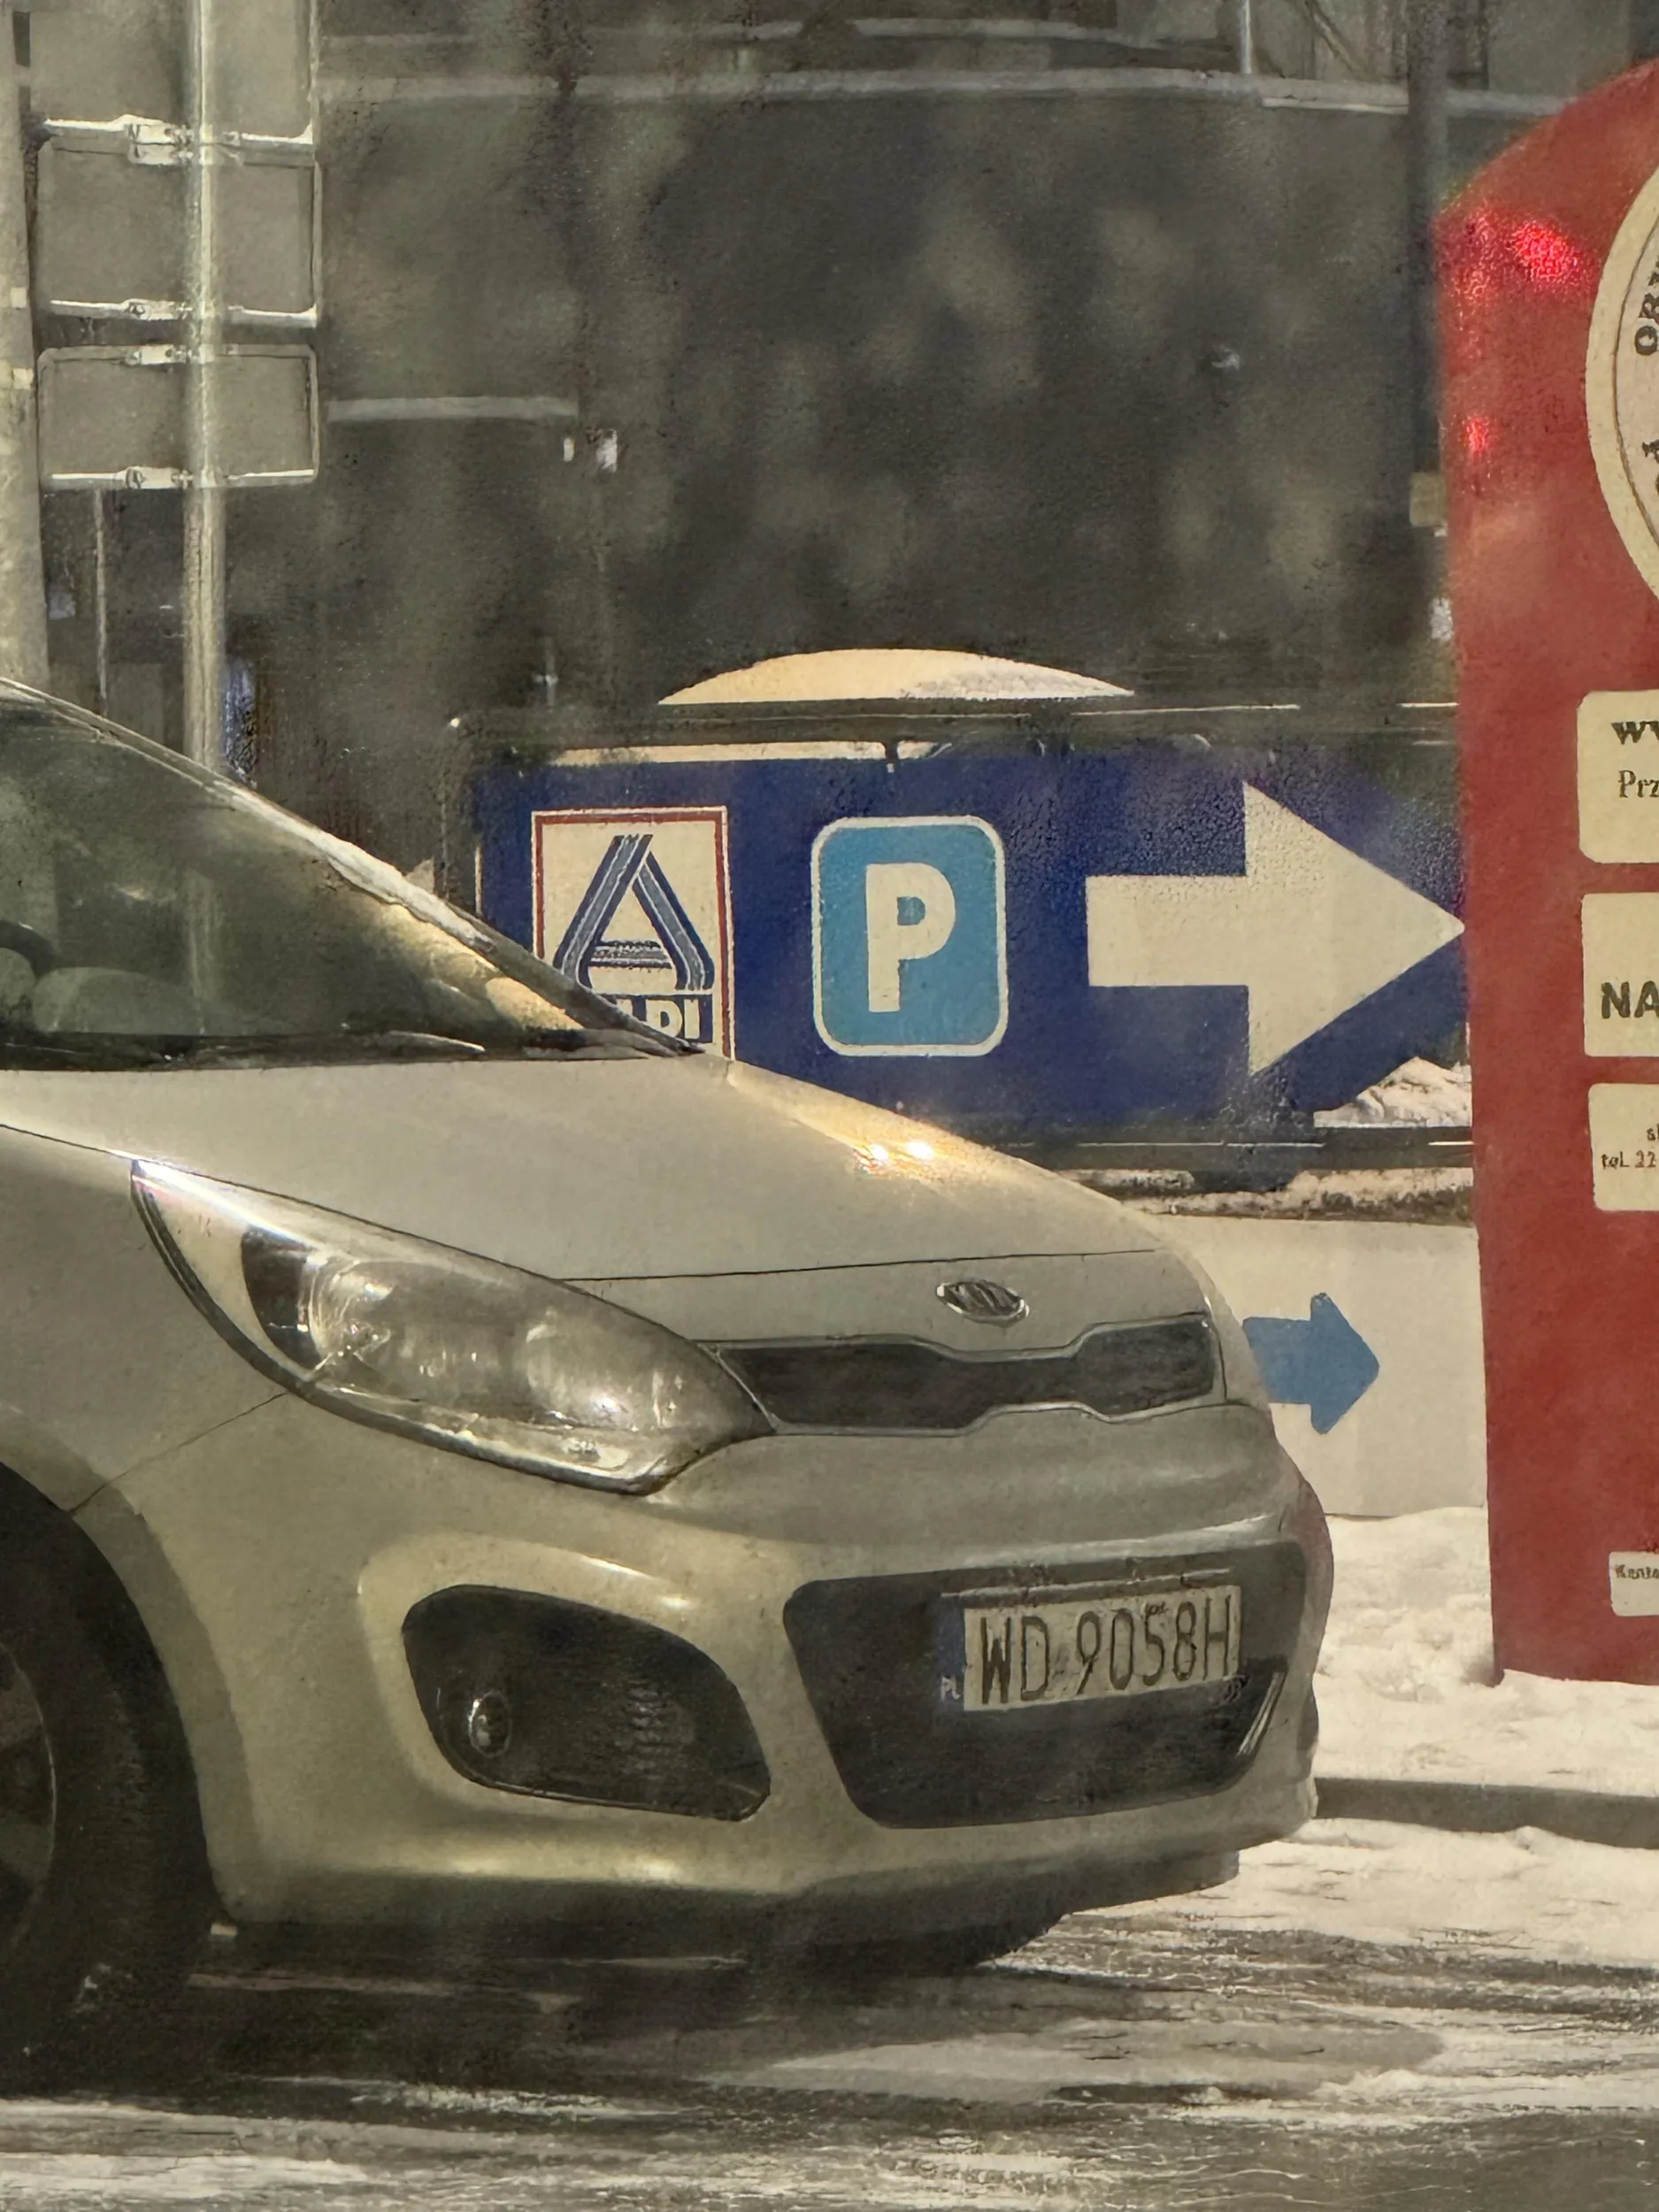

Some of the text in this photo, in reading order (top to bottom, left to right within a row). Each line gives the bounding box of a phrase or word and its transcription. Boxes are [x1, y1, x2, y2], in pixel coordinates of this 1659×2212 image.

[866, 862, 956, 1012] P
[979, 1594, 1232, 1705] WD 9058H
